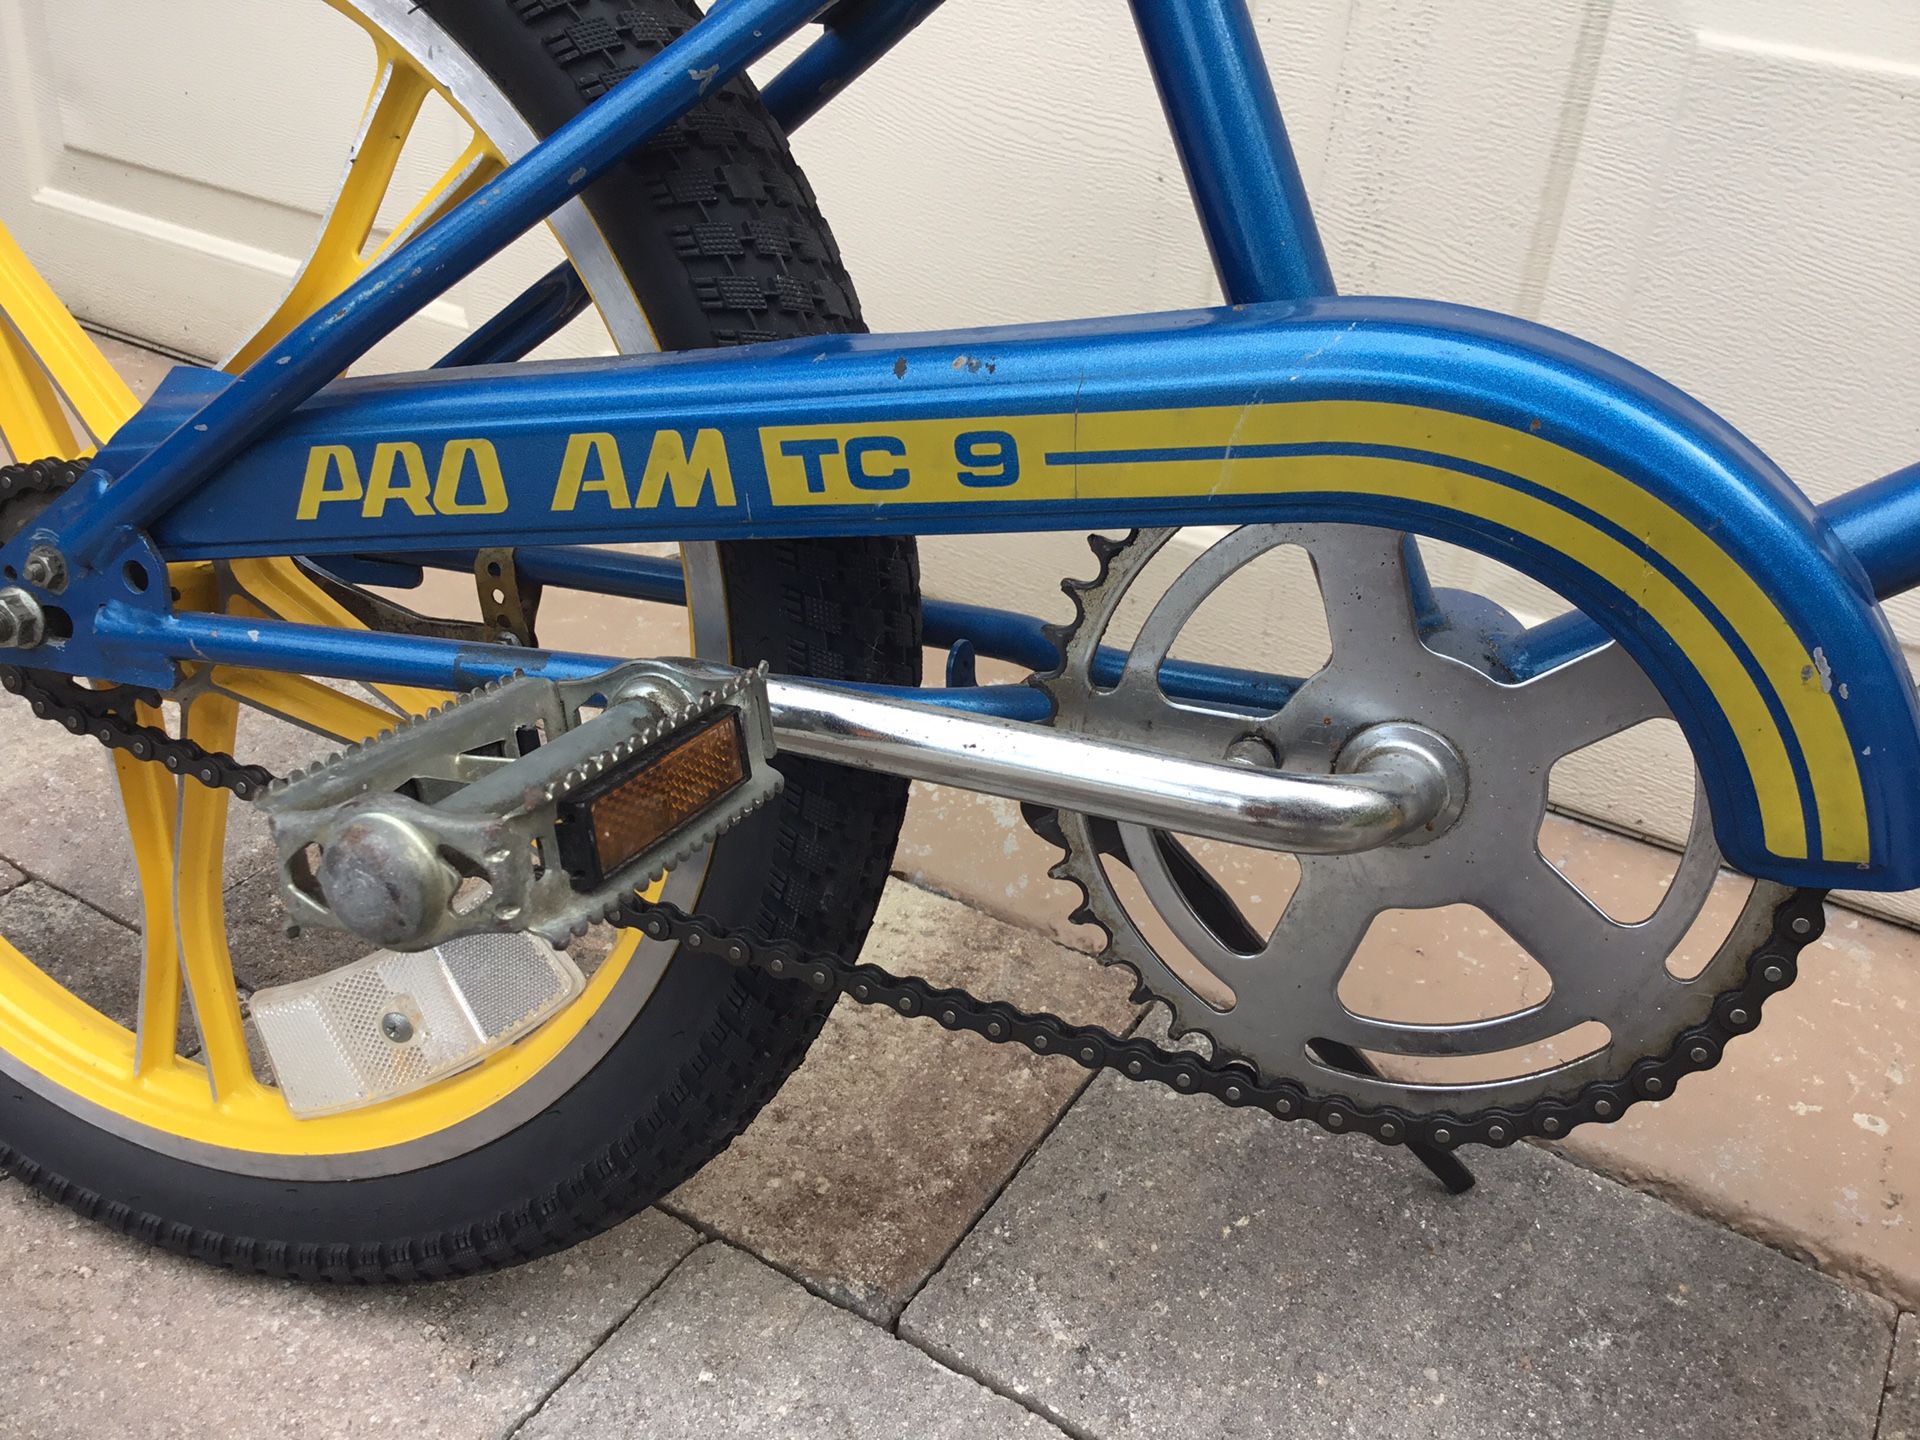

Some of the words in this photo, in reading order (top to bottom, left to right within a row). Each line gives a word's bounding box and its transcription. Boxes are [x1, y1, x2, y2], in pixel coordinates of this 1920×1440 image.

[296, 438, 509, 521] PRO
[551, 429, 736, 511] AM
[779, 435, 912, 495] TC
[953, 429, 1021, 489] 9
